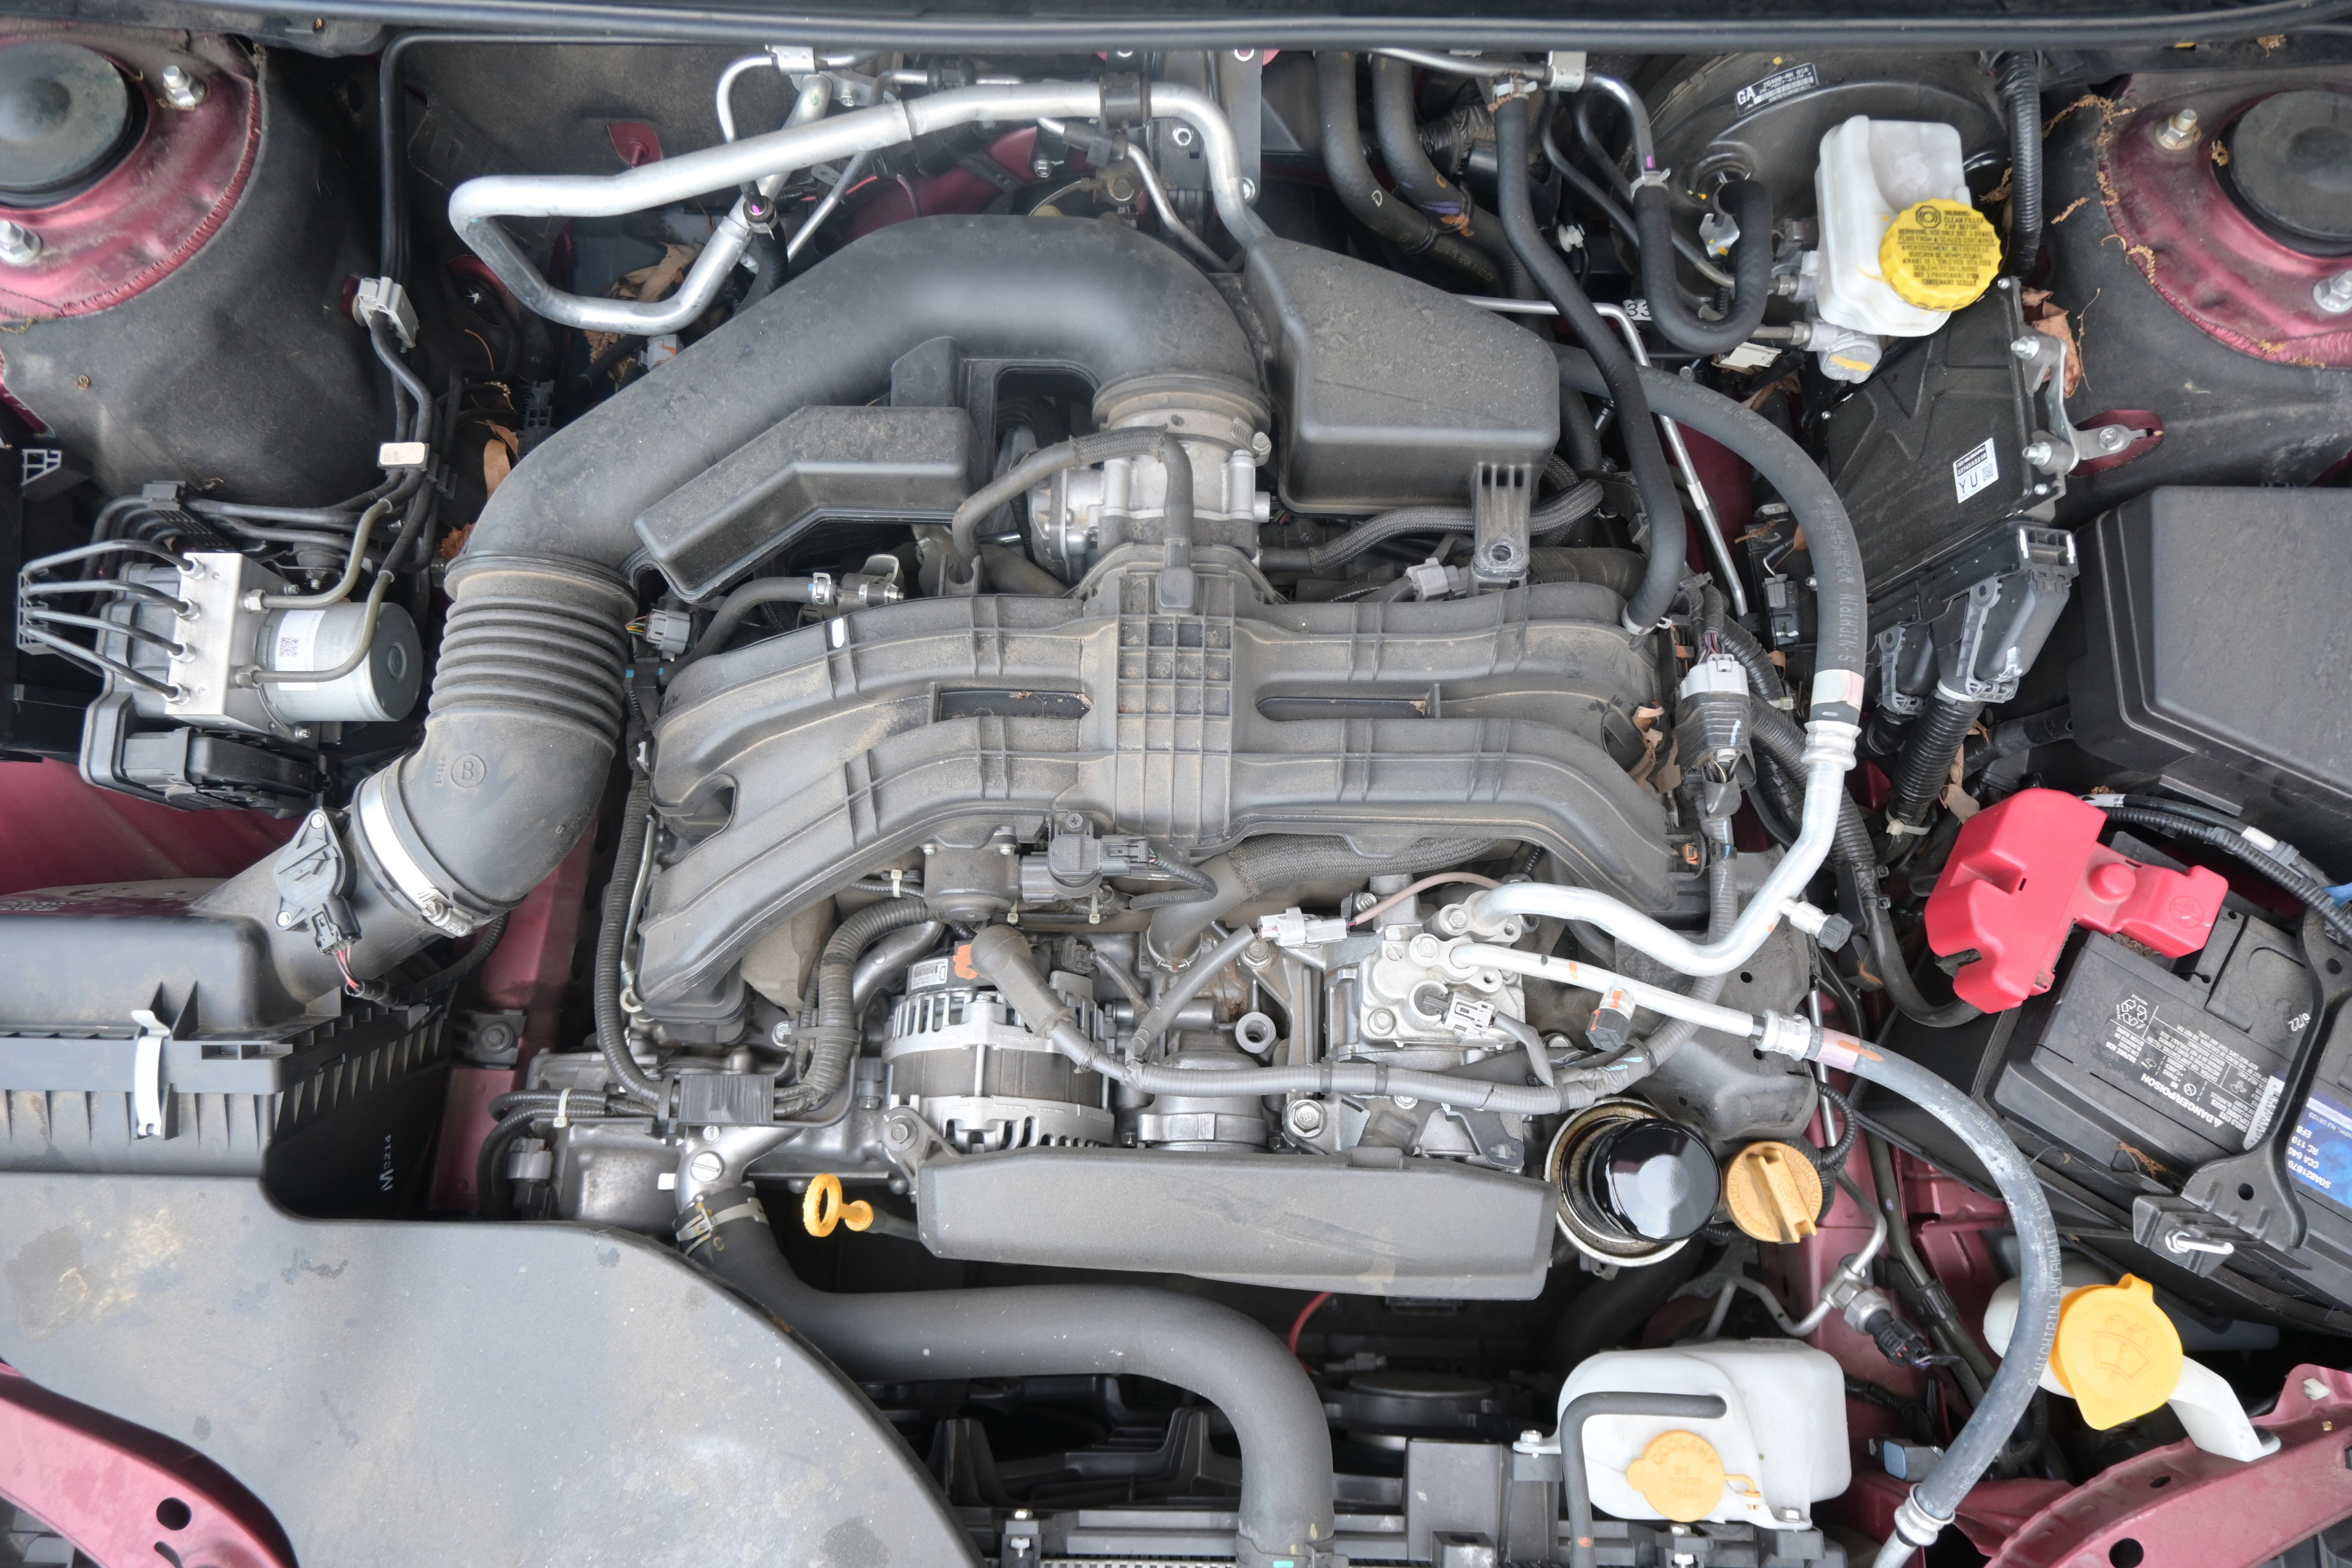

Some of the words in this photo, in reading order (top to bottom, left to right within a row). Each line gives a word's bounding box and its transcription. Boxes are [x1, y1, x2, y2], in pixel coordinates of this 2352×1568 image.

[1737, 86, 1756, 105] GA
[461, 760, 474, 781] B
[2131, 994, 2148, 1005] RECYCLE
[2116, 1026, 2130, 1037] BURNS
[2159, 1030, 2170, 1039] SEEK
[2183, 1029, 2193, 1037] NOT
[2105, 1041, 2117, 1051] ACID
[2120, 1035, 2142, 1052] BLINDNESS
[2129, 1034, 2145, 1046] SEVERE
[2146, 1035, 2162, 1048] FOLLOW
[2209, 1037, 2219, 1046] AND
[2118, 1041, 2131, 1052] CAUSE
[2130, 1048, 2139, 1057] CAN
[2174, 1045, 2190, 1058] VEHICLE
[2189, 1048, 2198, 1056] NOT
[2217, 1043, 2229, 1052] TIGHT
[2116, 1047, 2137, 1063] SULFURIC
[2224, 1054, 2239, 1065] REACH
[2228, 1049, 2240, 1059] CAPS
[2238, 1055, 2249, 1065] VENT
[2166, 1056, 2184, 1070] SMOKING
[2180, 1056, 2191, 1066] JUMP
[2207, 1059, 2223, 1072] MANUAL
[2209, 1054, 2225, 1067] SERVICE
[2238, 1062, 2247, 1070] THE
[2248, 1061, 2259, 1071] KEEP
[2164, 1063, 2181, 1075] FLAMES
[2190, 1063, 2200, 1071] FOR
[2193, 1057, 2220, 1077] INSTRUCTIONS
[2162, 1068, 2178, 1081] SPARKS
[2252, 1071, 2262, 1079] OUT
[2170, 1080, 2178, 1089] NO
[2247, 1076, 2258, 1086] HELP
[2140, 1073, 2214, 1123] DANGER/POISON
[2210, 1091, 2232, 1108] BLINDNESS
[2210, 1098, 2227, 1111] GASES
[2231, 1104, 2245, 1115] CAUSE
[2234, 1099, 2249, 1111] INJURY
[2218, 1111, 2232, 1122] EYES
[2225, 1108, 2250, 1126] EXPLOSIVE
[2243, 1112, 2252, 1120] CAN
[2307, 1111, 2328, 1126] 08103
[2230, 1118, 2248, 1132] SHIELD
[2295, 1124, 2313, 1138] EFB
[2327, 1122, 2337, 1130] NJ
[709, 1127, 714, 1138] 1
[2290, 1135, 2307, 1149] 110
[2286, 1146, 2303, 1160] 640
[2306, 1143, 2319, 1156] RC
[2301, 1154, 2320, 1169] CCA
[1732, 1162, 1745, 1178] SEE
[1785, 1149, 1819, 1187] ENGINE
[1809, 1192, 1820, 1211] OIL
[1651, 1438, 1715, 1466] COOLANT
[1674, 1467, 1689, 1475] SEE
